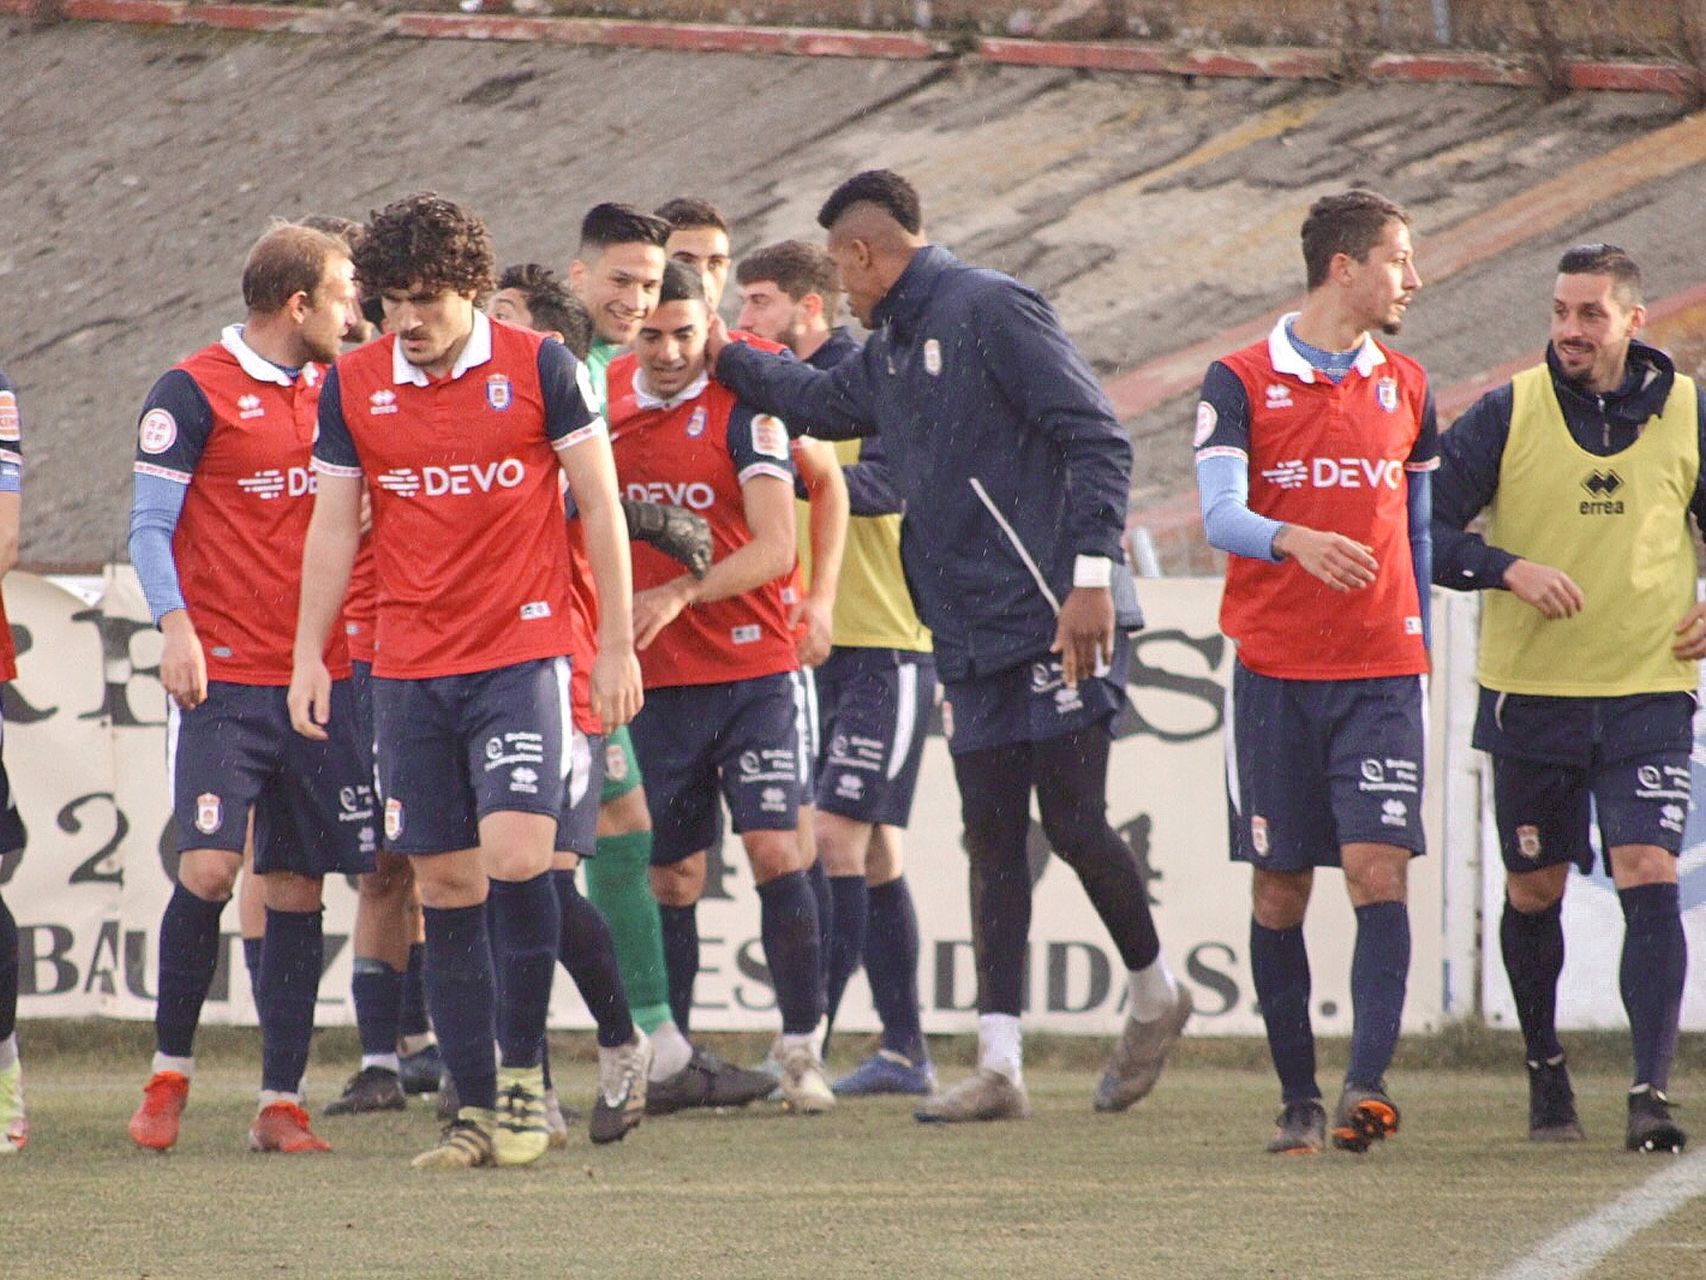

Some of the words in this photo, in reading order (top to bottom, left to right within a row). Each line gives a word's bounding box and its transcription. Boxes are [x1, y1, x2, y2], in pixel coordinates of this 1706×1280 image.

[422, 458, 525, 496] DEVO
[1312, 456, 1404, 490] DEVO
[626, 482, 716, 510] DEVO
